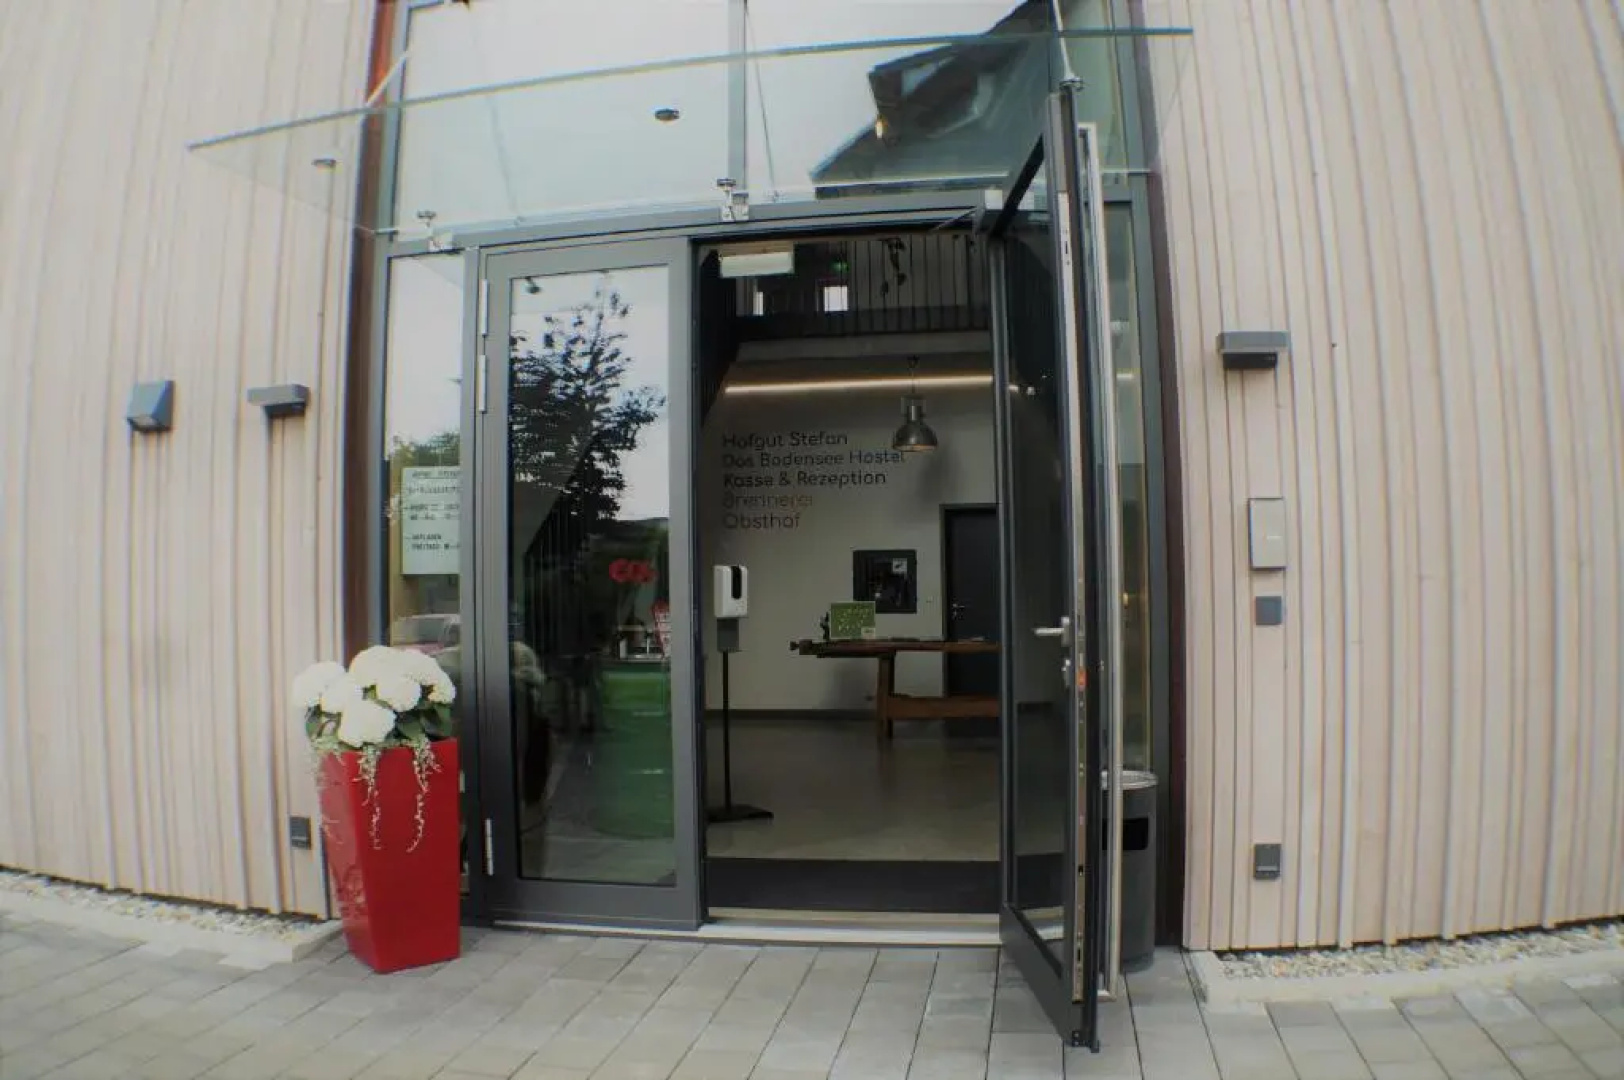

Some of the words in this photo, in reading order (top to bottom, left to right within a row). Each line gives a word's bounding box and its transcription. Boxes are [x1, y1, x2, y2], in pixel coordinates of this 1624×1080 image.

[723, 433, 784, 450] Hofgut
[789, 430, 848, 447] Stefan
[723, 453, 754, 468] Das
[760, 452, 845, 467] Bodensee
[850, 450, 905, 464] Hostel
[723, 472, 774, 488] Kasse
[779, 471, 790, 487] &
[797, 470, 886, 488] Rezeption
[723, 513, 800, 530] Obsthof
